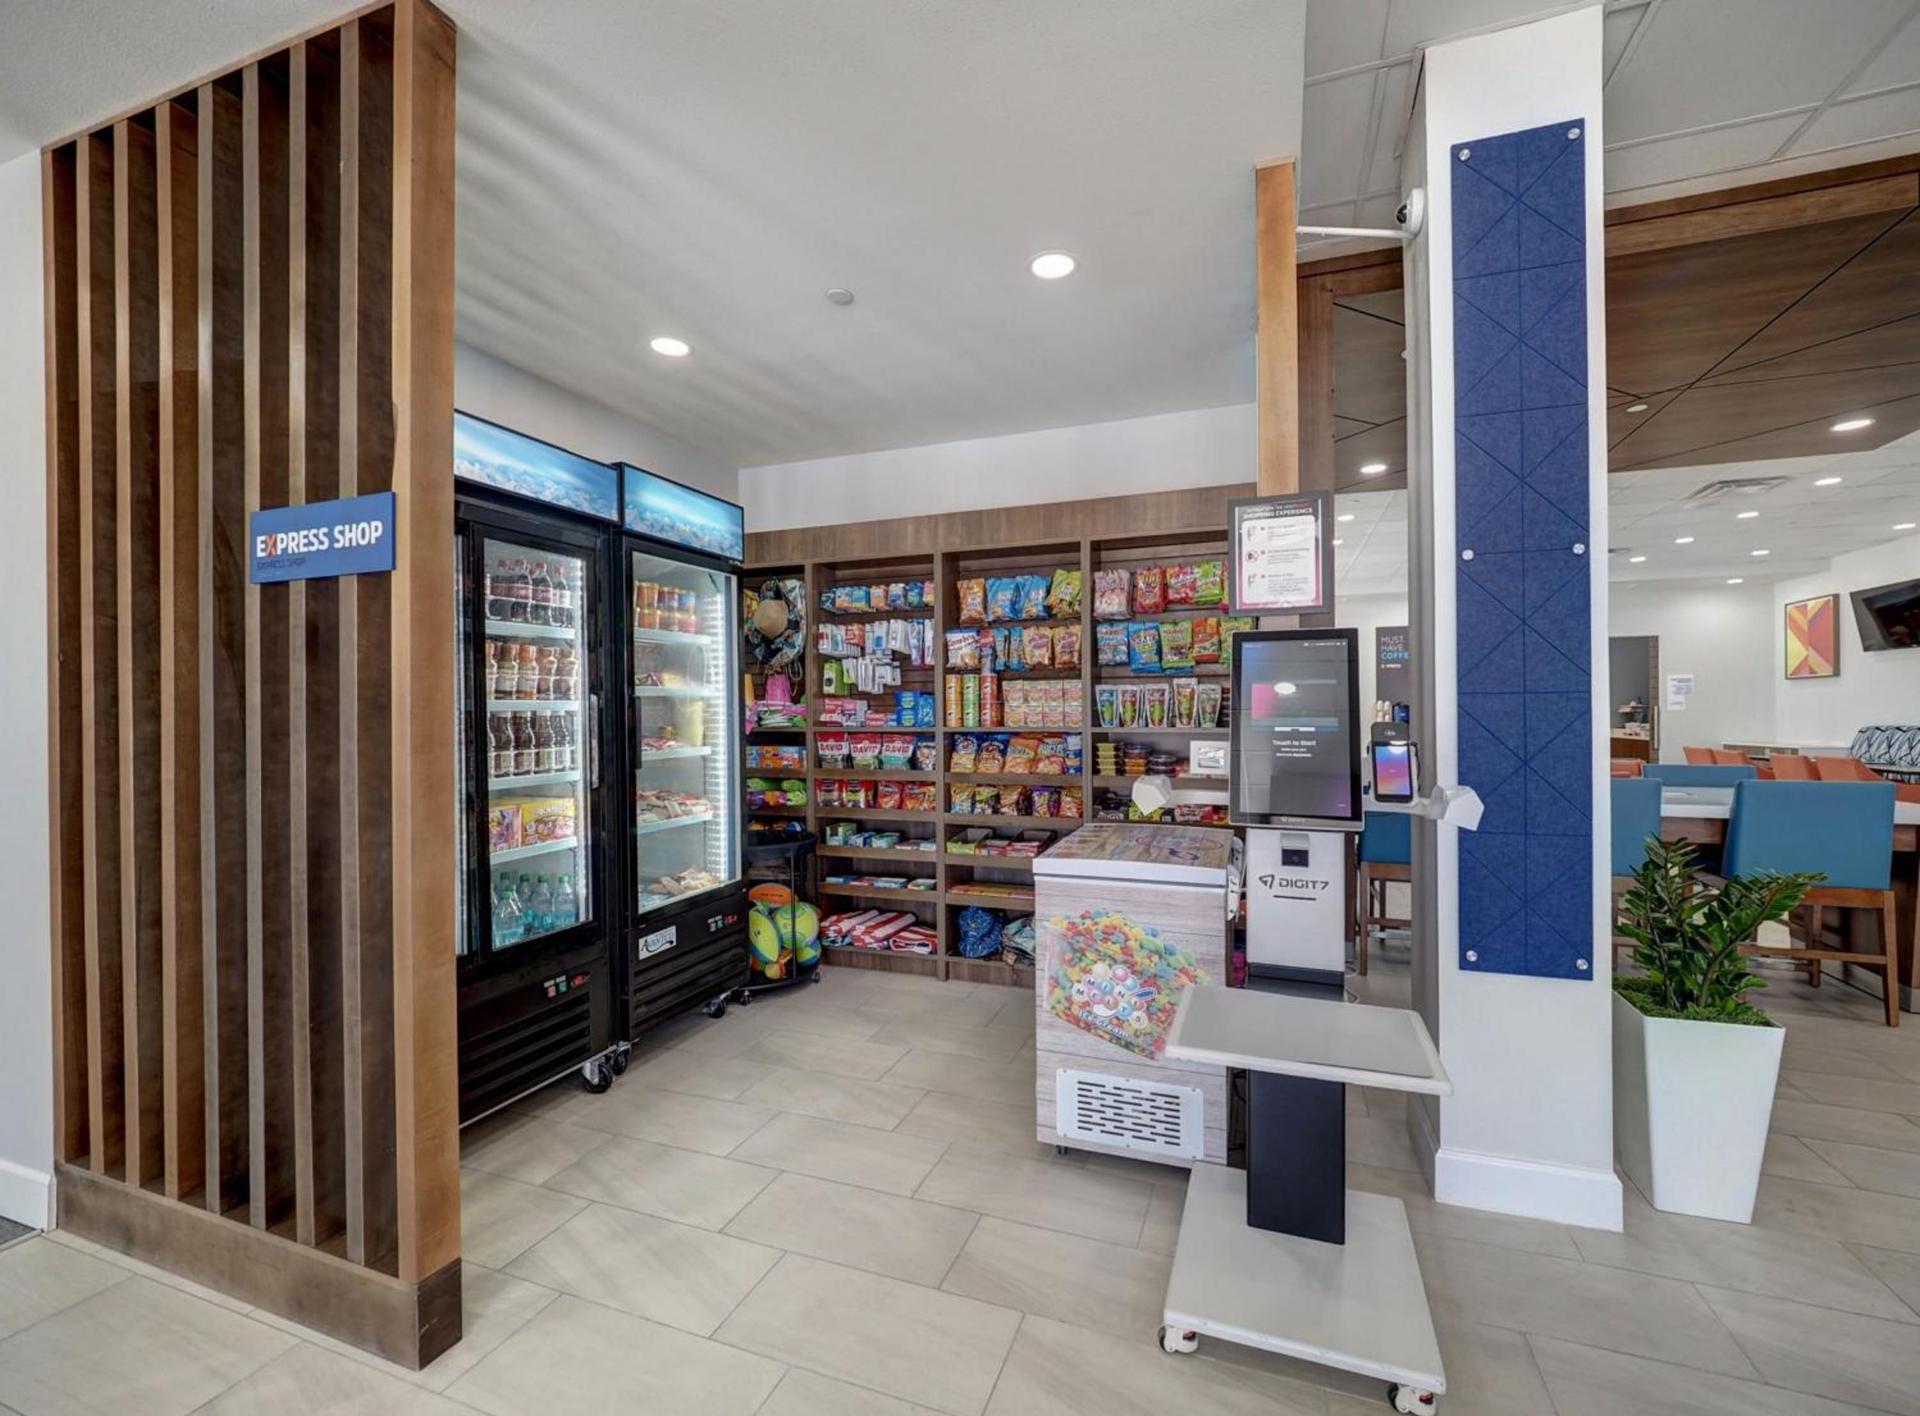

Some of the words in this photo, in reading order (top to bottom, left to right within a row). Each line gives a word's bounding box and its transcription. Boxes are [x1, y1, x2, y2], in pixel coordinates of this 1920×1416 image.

[256, 527, 330, 558] EXPRESS
[333, 520, 384, 549] SHOP
[819, 743, 844, 752] DAVID
[852, 744, 878, 754] DAVID
[884, 744, 910, 753] DAVID
[1278, 877, 1331, 891] DIGIT7
